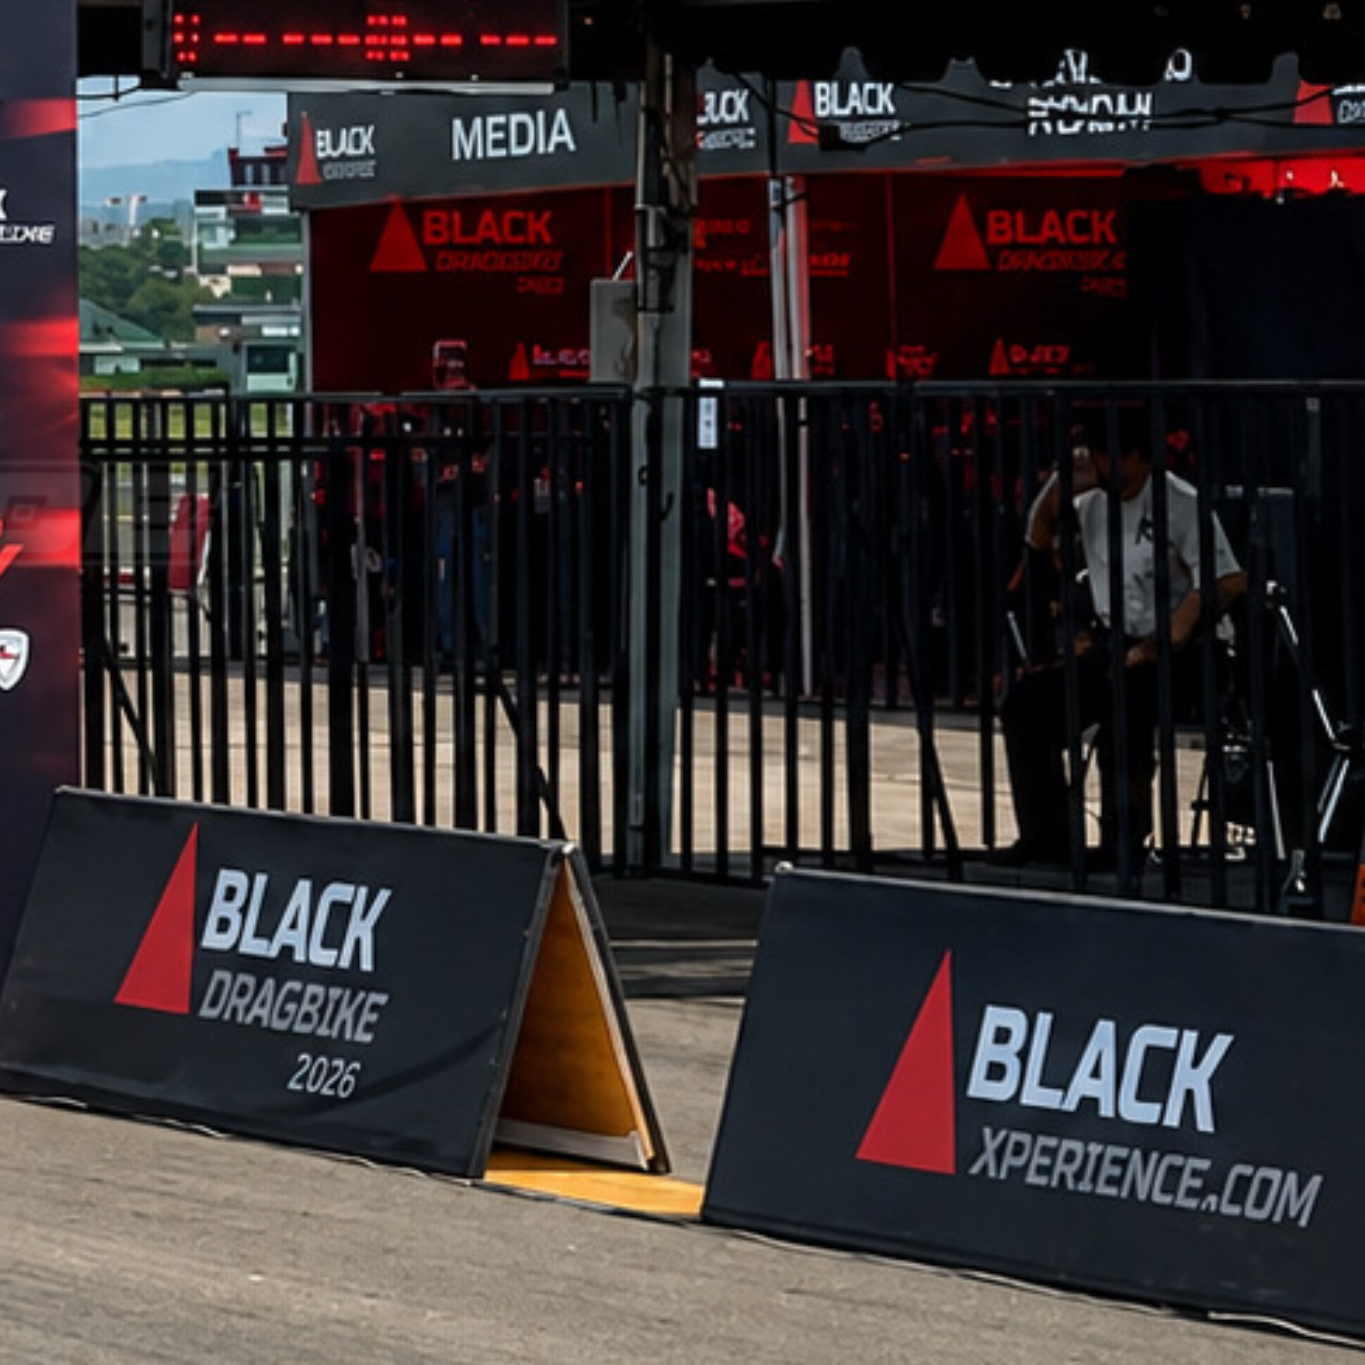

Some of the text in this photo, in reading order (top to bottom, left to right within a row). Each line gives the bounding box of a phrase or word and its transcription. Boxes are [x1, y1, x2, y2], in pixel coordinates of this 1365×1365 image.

[815, 82, 895, 116] BLACK
[452, 109, 575, 160] MEDIA
[423, 210, 552, 245] BLACK
[987, 210, 1117, 245] BLACK
[201, 869, 391, 972] BLACK
[198, 969, 389, 1043] DRAGBIKE
[287, 1053, 361, 1099] 2026
[967, 1005, 1233, 1133] BLACK
[969, 1126, 1323, 1228] XPERIENCE.COM
